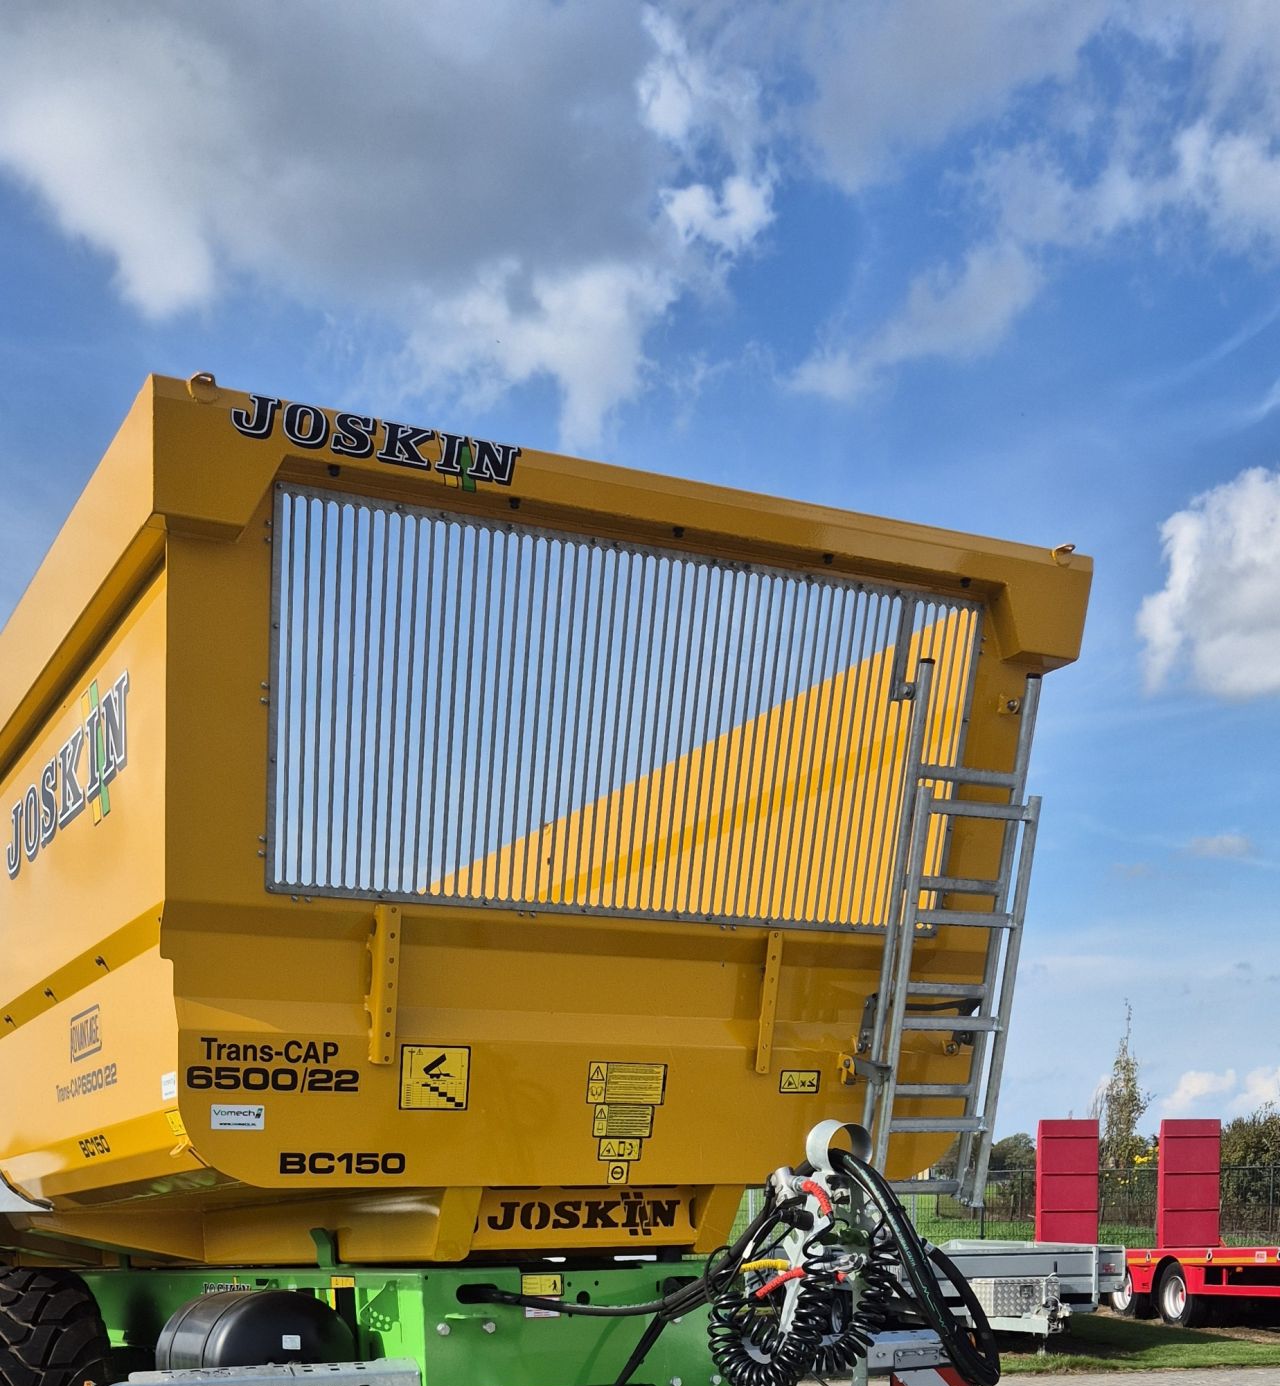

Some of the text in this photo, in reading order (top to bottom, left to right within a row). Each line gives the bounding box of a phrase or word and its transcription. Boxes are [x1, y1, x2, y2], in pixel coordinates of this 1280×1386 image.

[231, 394, 521, 485] JOSKIN
[6, 668, 130, 880] JOSKIN
[201, 1037, 339, 1064] Trans-CAP
[187, 1066, 359, 1093] 6500/22
[213, 1109, 256, 1117] Vomech
[78, 1134, 111, 1158] BC150
[280, 1152, 406, 1174] BC150
[487, 1198, 681, 1232] JOSKIN
